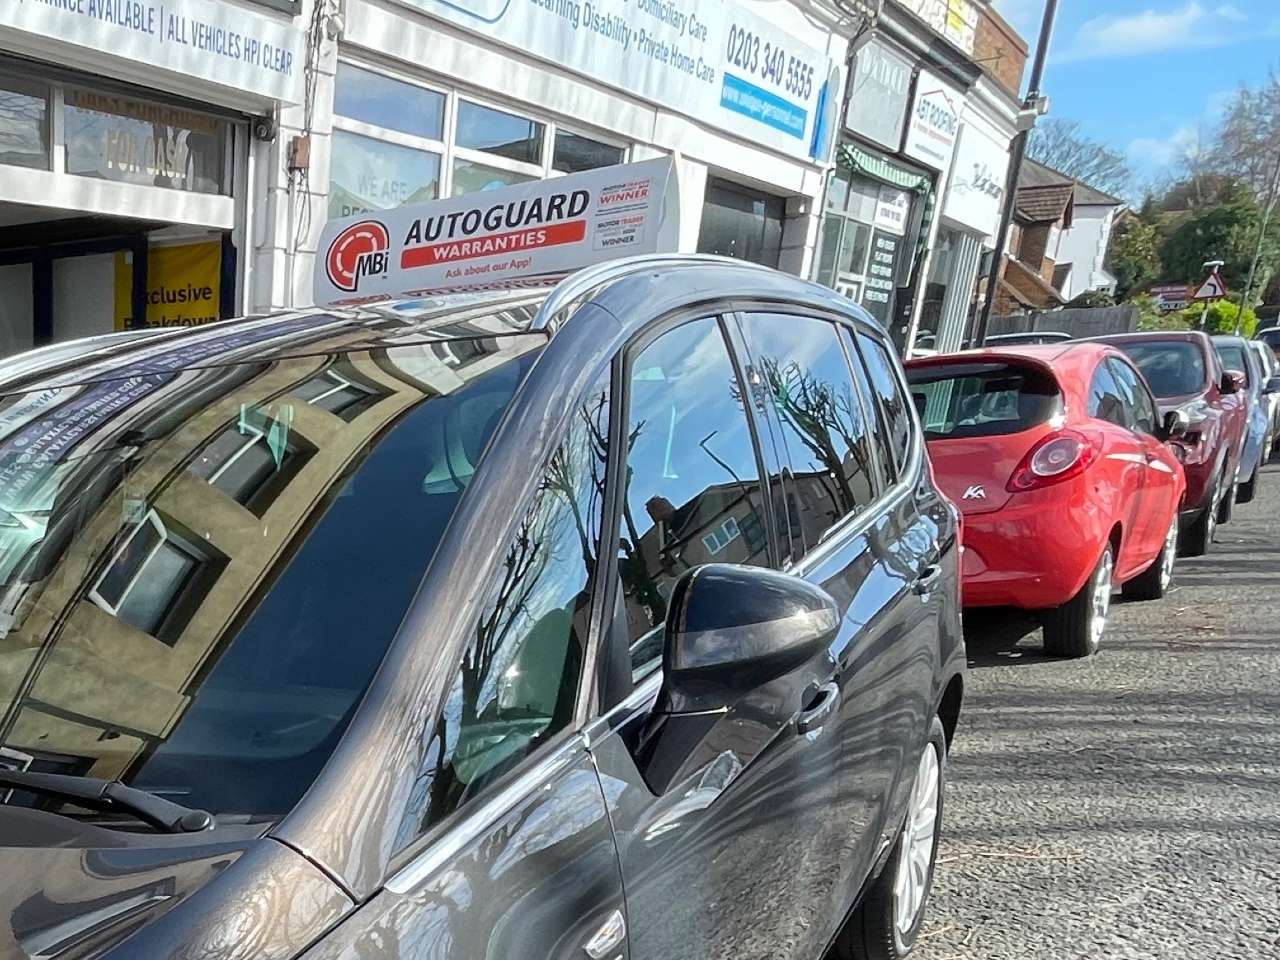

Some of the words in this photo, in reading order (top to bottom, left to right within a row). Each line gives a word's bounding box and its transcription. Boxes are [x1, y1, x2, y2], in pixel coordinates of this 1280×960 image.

[87, 0, 155, 35] AVAILABLE
[169, 13, 189, 46] ALL
[192, 20, 242, 60] VEHICLES
[244, 37, 261, 66] HPI
[262, 43, 293, 77] CLEAR
[688, 13, 708, 42] Care
[583, 2, 632, 51] Disability
[637, 28, 669, 64] Private
[671, 43, 695, 75] Home
[696, 57, 715, 84] Care
[726, 23, 761, 74] 0203
[761, 42, 785, 86] 340
[785, 55, 814, 101] 5555
[356, 174, 378, 197] WE
[380, 180, 408, 200] ARE
[600, 189, 648, 205] WINNER
[404, 189, 590, 246] AUTOGUARD
[433, 230, 547, 260] WARRANTIES
[357, 252, 389, 278] MBi
[445, 268, 463, 278] Ask
[464, 264, 491, 276] about
[492, 262, 508, 272] our
[509, 257, 532, 271] App!
